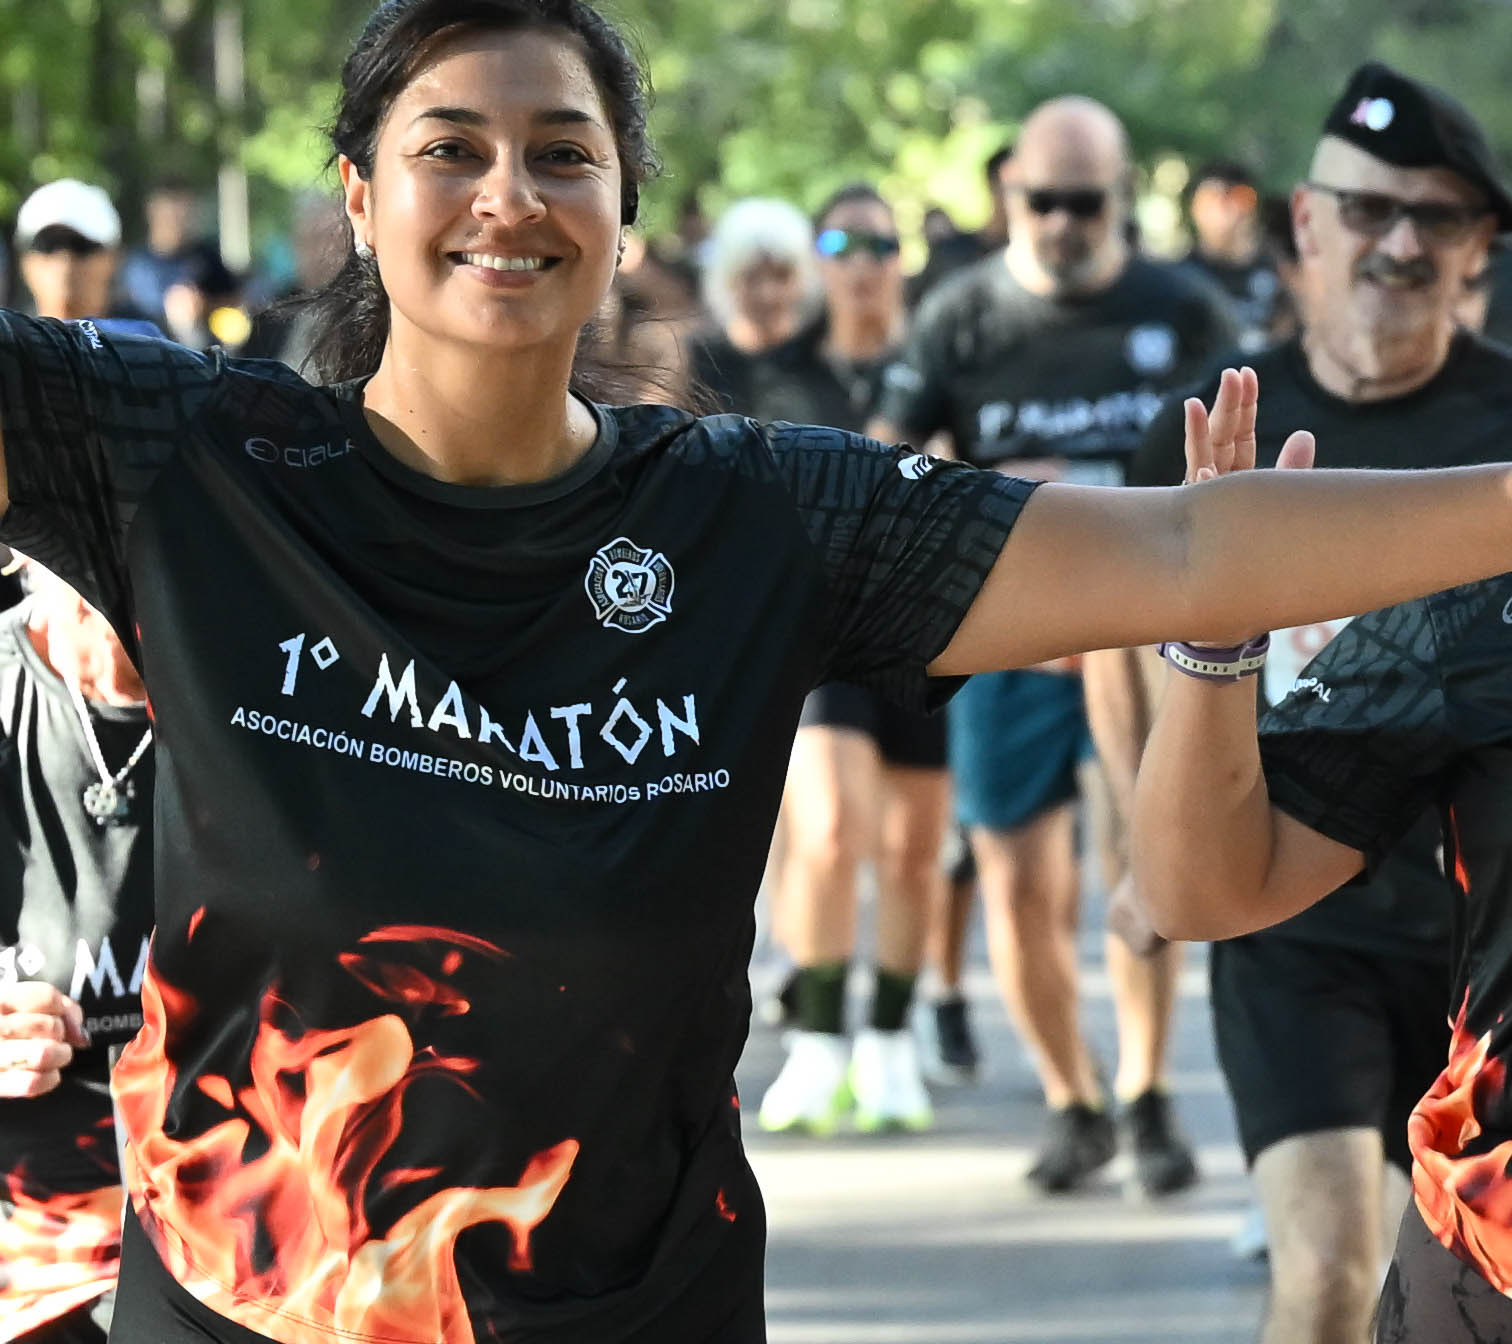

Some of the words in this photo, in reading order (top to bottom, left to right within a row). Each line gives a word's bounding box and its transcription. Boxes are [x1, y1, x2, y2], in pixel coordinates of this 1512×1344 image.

[611, 569, 649, 599] 27
[278, 632, 341, 697] 1°
[230, 705, 365, 759] ASOCIACIÓN
[370, 742, 494, 787] BOMBEROS
[499, 769, 642, 805] VOLUNTARIOS
[647, 768, 731, 803] ROSARIO
